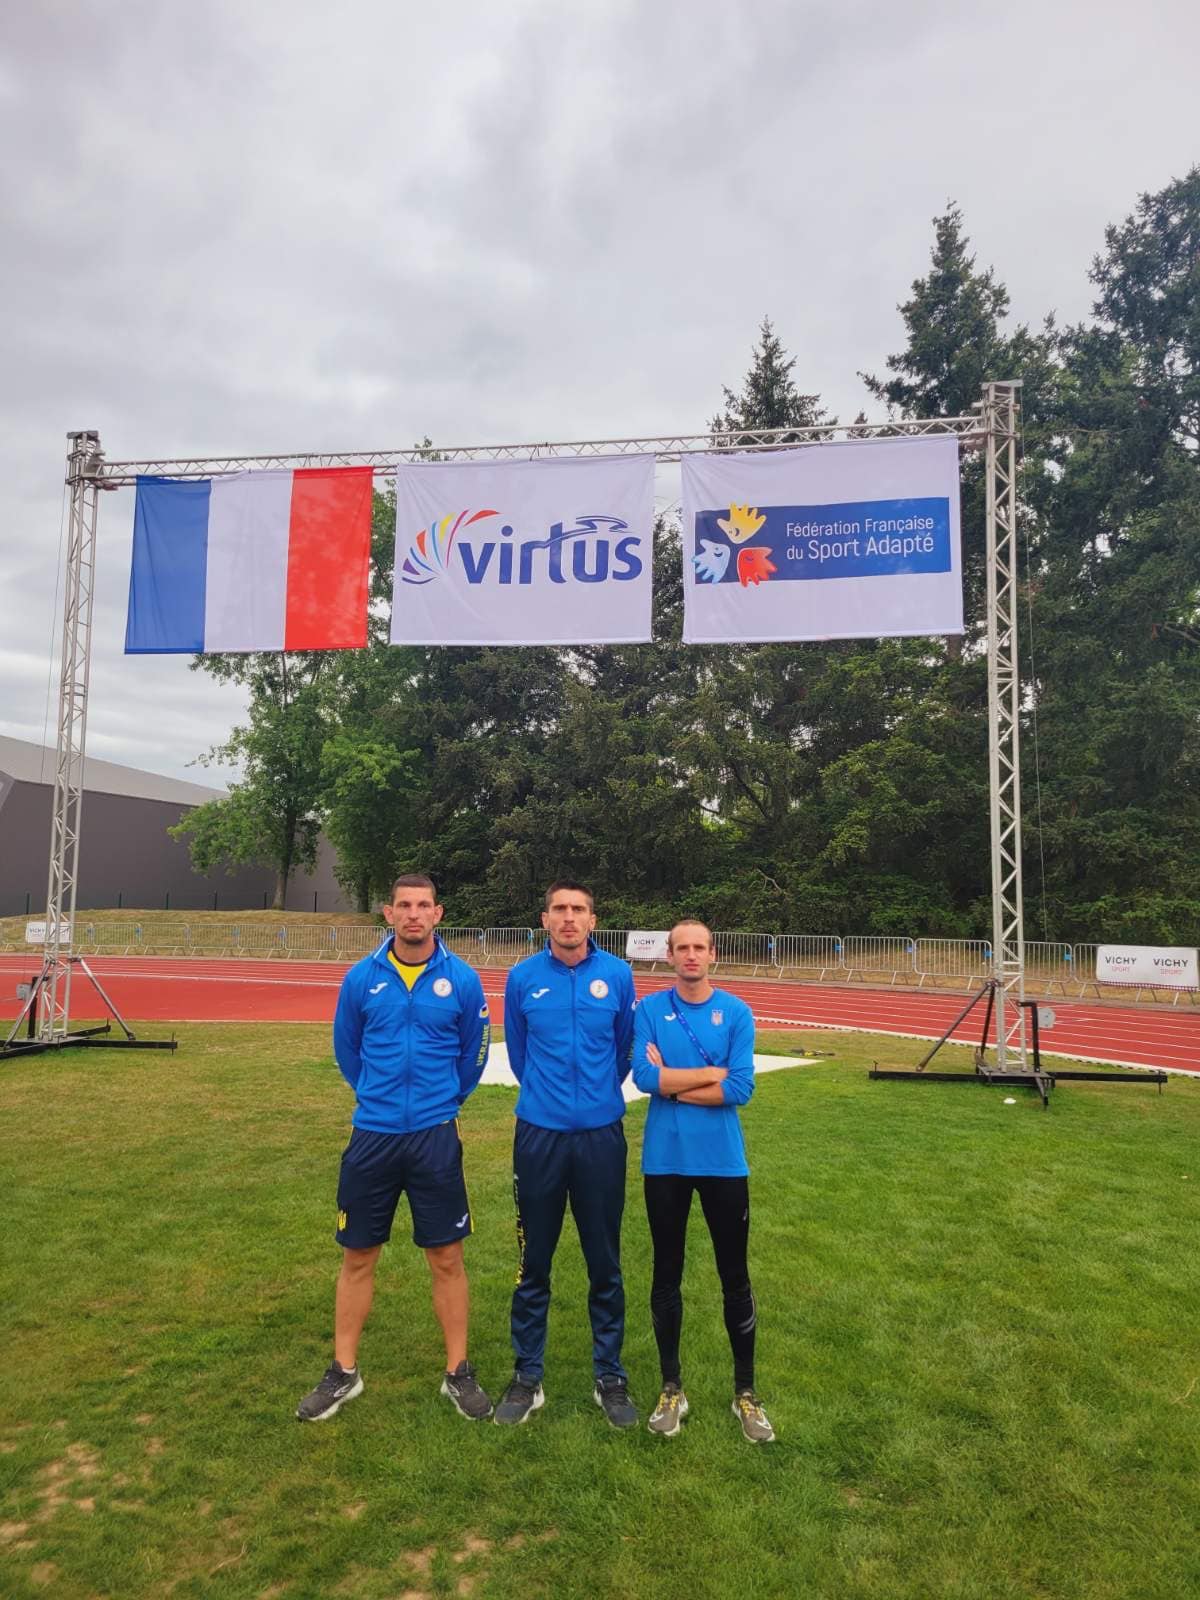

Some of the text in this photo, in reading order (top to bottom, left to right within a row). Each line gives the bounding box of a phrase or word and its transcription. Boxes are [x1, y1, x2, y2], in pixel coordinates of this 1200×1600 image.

[786, 515, 934, 538] Fédération Française
[457, 517, 643, 585] virtus
[786, 533, 934, 563] du Sport Adapté
[1105, 956, 1189, 967] VICHY VICHY
[476, 1023, 490, 1067] UKRAINE
